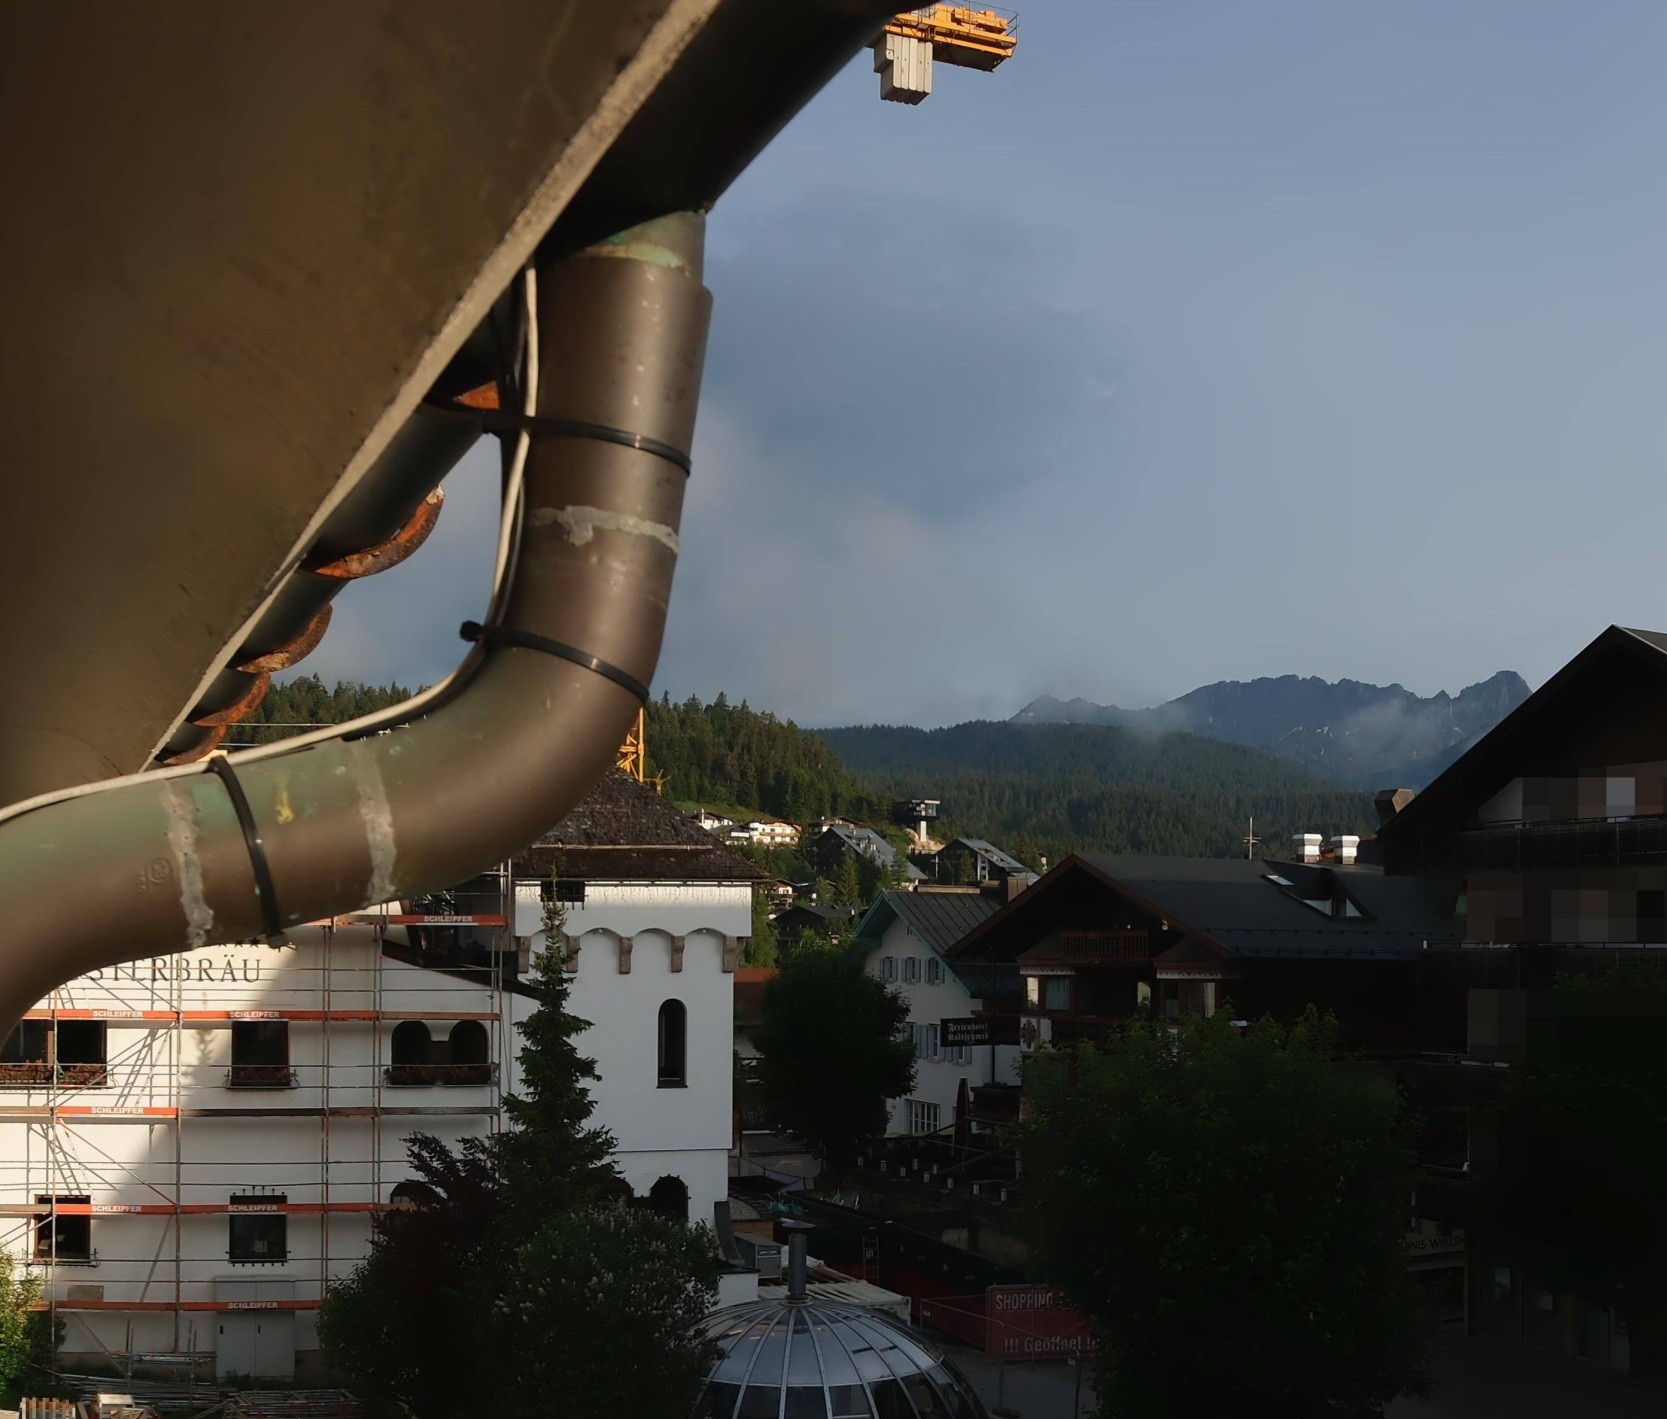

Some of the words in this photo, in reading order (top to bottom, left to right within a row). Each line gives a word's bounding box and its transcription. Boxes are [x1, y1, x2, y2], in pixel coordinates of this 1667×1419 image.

[424, 915, 473, 923] SCHLEIPFER
[92, 1010, 143, 1018] SCHLEIPFER
[91, 1107, 144, 1115] SCHLEIPFER
[228, 1301, 278, 1309] SCHLEIPFER
[995, 1292, 1053, 1310] SHOPPING
[1024, 1335, 1081, 1352] Geöffnet
